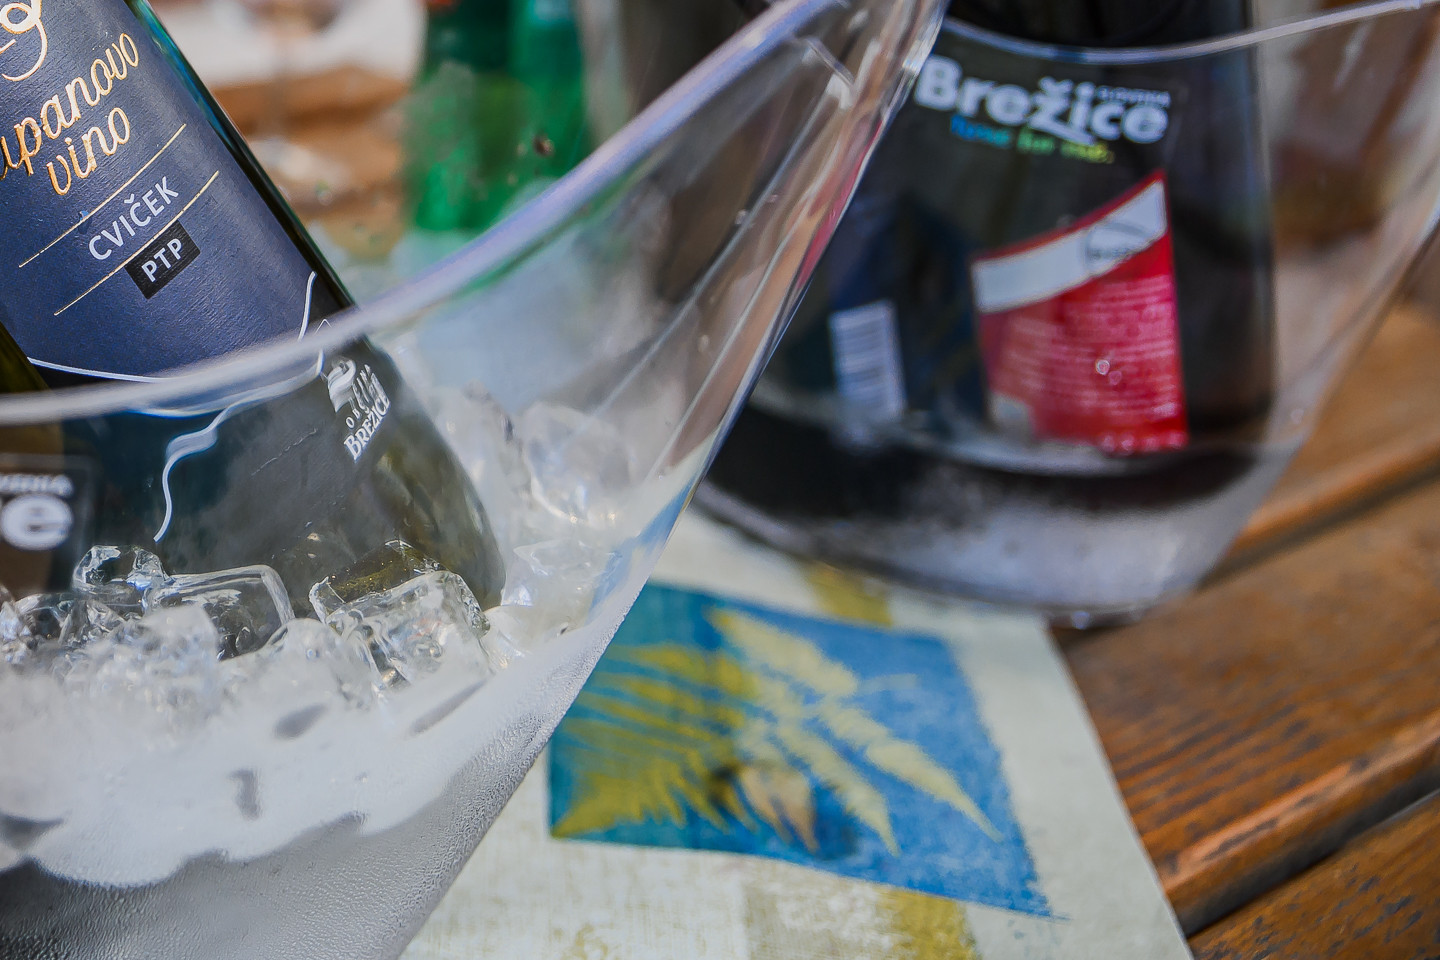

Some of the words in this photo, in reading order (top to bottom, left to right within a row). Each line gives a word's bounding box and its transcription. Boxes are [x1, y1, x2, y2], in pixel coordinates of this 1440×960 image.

[914, 54, 1168, 146] Brežice
[46, 107, 131, 196] vino
[88, 175, 179, 261] CVIČEK
[141, 237, 183, 283] PTP
